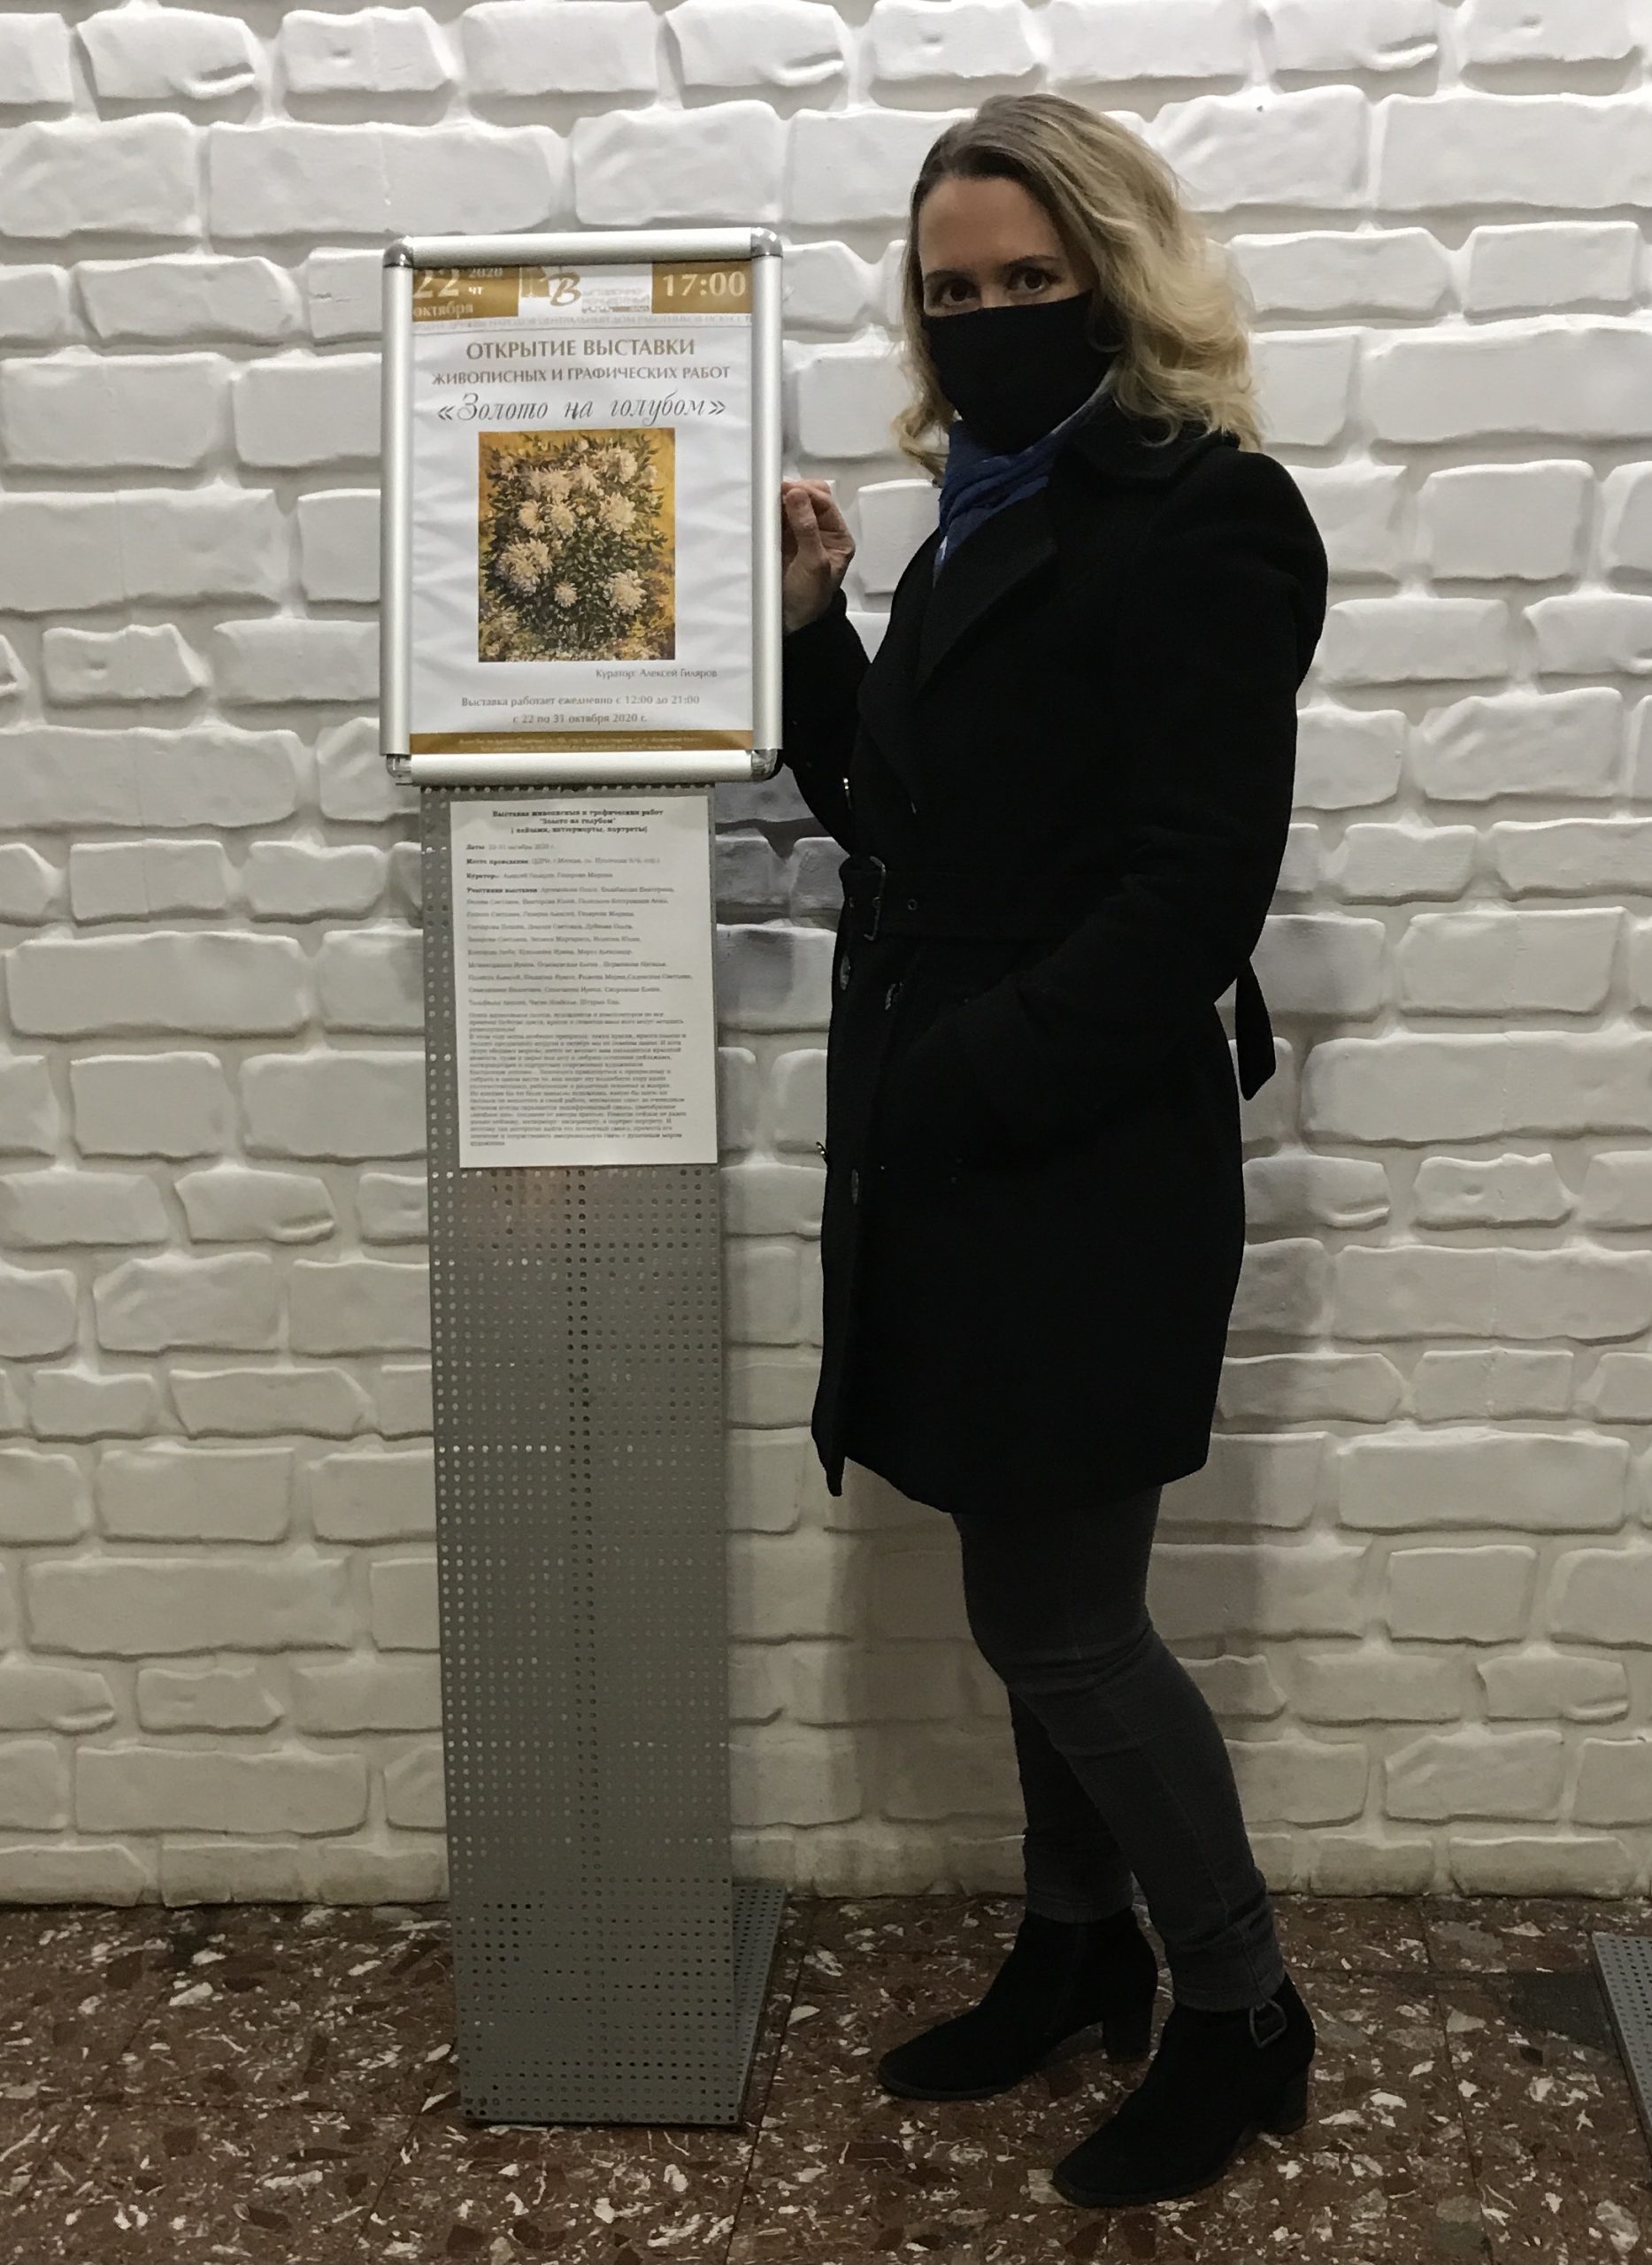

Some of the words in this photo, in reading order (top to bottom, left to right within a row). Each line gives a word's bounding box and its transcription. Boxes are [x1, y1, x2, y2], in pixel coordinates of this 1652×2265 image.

[663, 271, 746, 297] 17:00
[413, 301, 474, 319] октября
[466, 340, 575, 360] ОТКРЫТИЕ
[583, 339, 695, 356] ВЫСТАВКИ
[432, 370, 547, 386] ЖИВОПИСНЫХ
[551, 369, 563, 381] И
[568, 366, 677, 381] ГРАФИЧЕСКИХ
[683, 365, 730, 380] РАБОТ
[437, 393, 548, 421] «Золото
[564, 400, 593, 420] на
[639, 668, 678, 678] Алексей
[461, 697, 508, 707] Выставка
[511, 695, 555, 708] работает
[558, 695, 613, 706] ежедневно
[625, 695, 653, 705] 12:00
[656, 696, 668, 706] до
[672, 695, 700, 704] 21:00
[522, 714, 534, 724] 22
[537, 715, 550, 724] по
[554, 714, 565, 724] 31
[568, 713, 610, 726] октября
[612, 713, 638, 723] 2020
